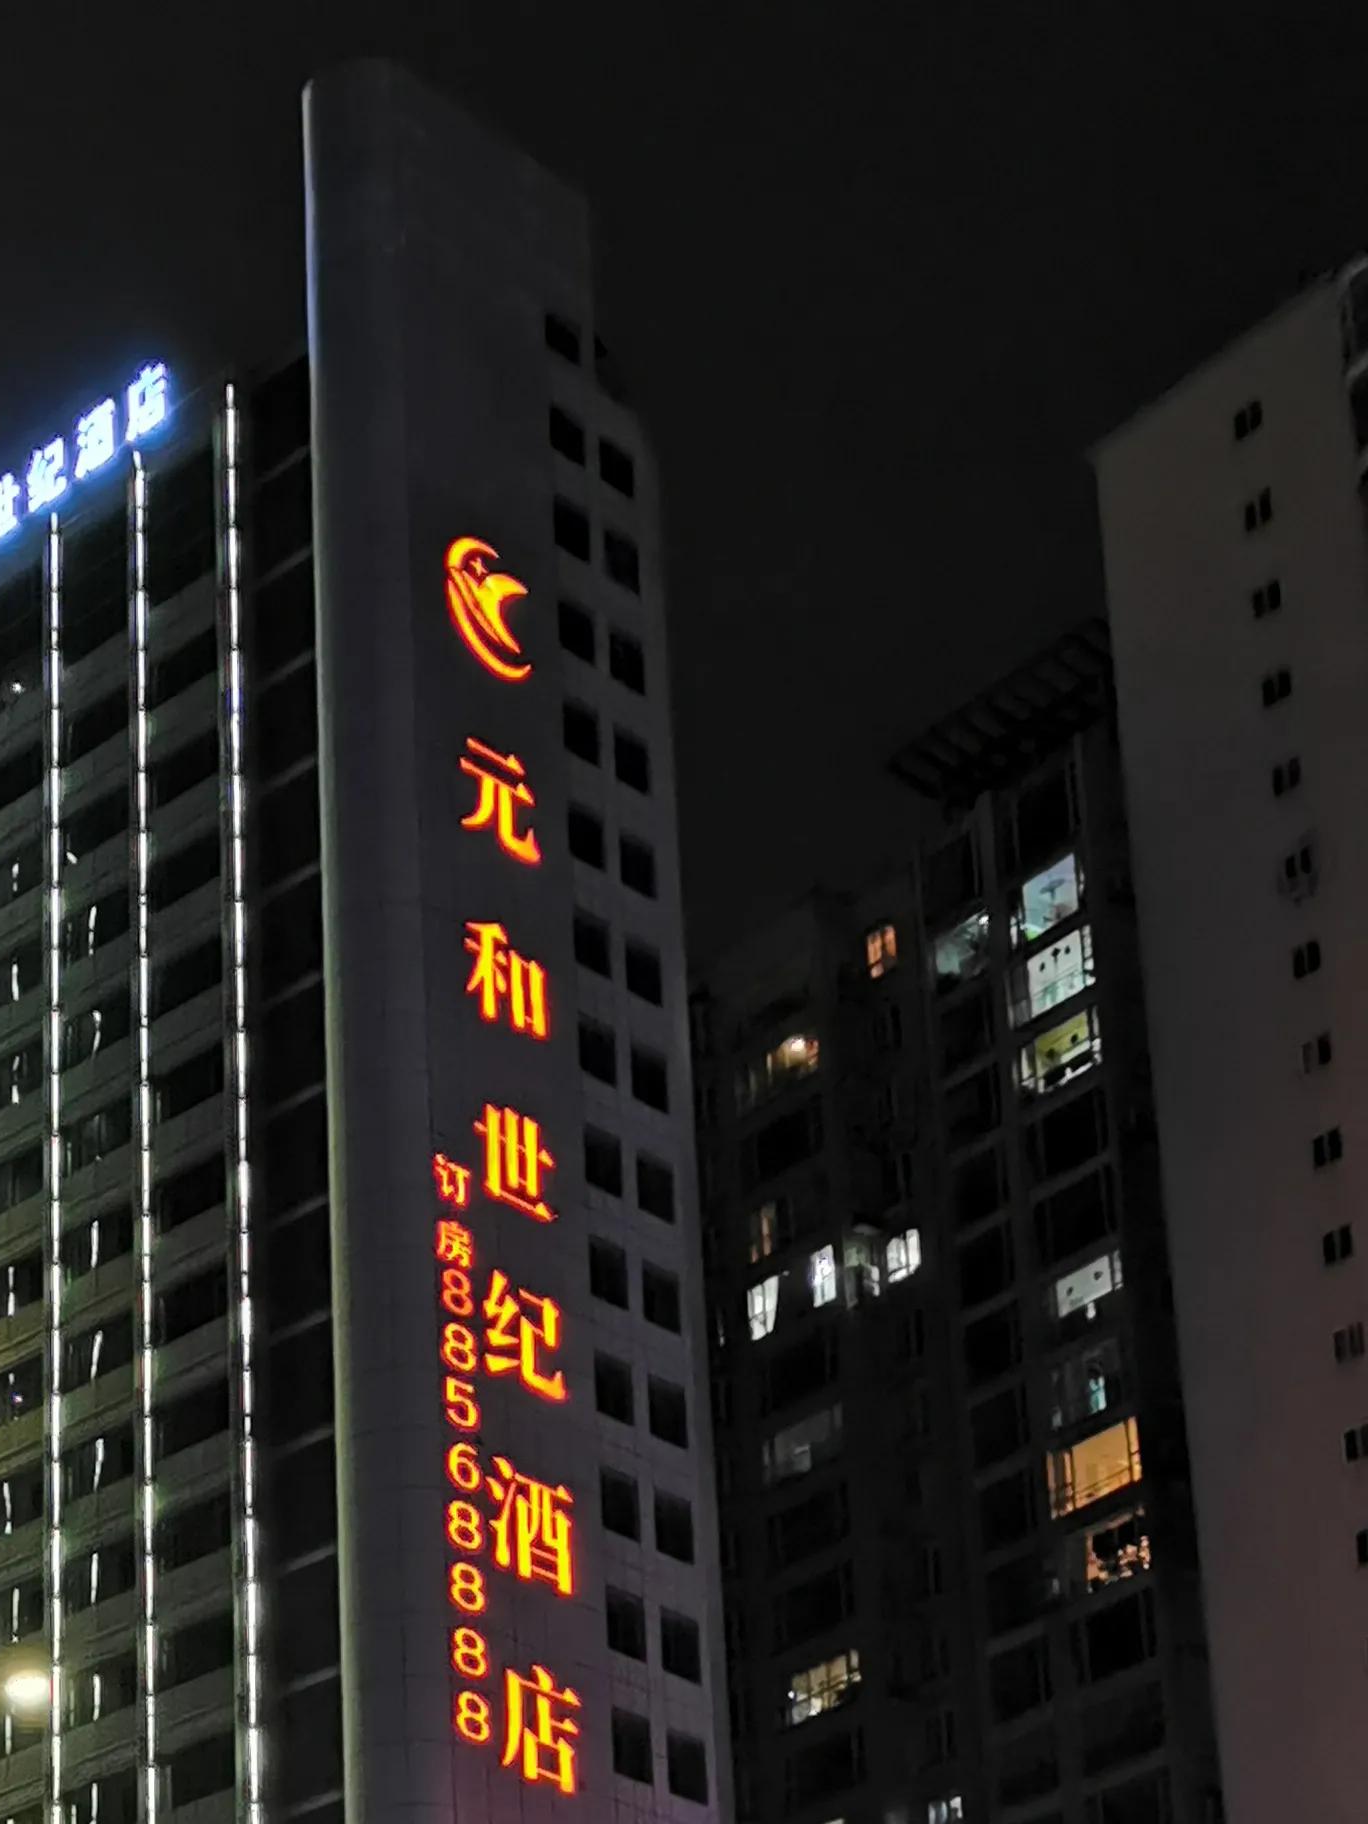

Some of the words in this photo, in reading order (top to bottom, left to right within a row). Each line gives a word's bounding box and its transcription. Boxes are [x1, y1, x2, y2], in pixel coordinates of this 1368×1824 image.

[458, 736, 583, 1796] 元和世纪酒店
